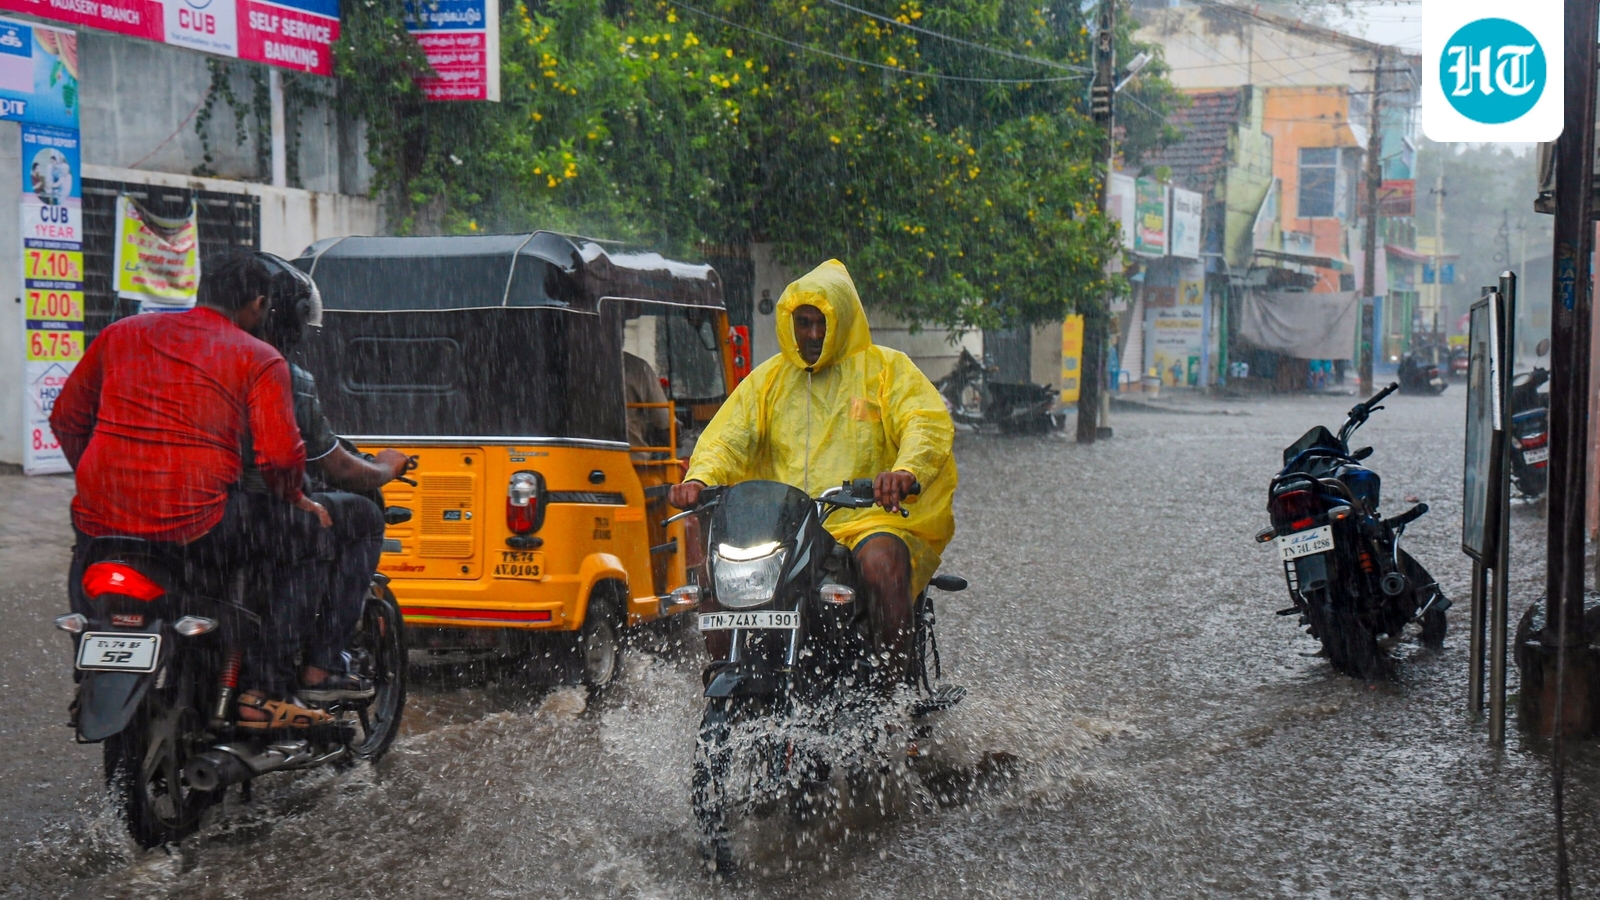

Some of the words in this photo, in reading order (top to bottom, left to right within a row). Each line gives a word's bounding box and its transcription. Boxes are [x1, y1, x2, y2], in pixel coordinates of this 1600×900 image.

[100, 4, 140, 25] BRANCH
[179, 9, 215, 35] CUB
[249, 11, 279, 33] SELF
[281, 18, 330, 44] SERVICE
[264, 41, 318, 67] BANKING
[40, 206, 69, 223] CUB
[30, 251, 79, 278] 7.10%
[33, 280, 54, 288] SENIOR
[29, 292, 80, 318] 7.00%
[31, 332, 81, 357] 6.75%
[1283, 546, 1296, 557] TN
[1297, 543, 1312, 554] 74L
[1313, 538, 1331, 551] 4286
[494, 564, 540, 576] AV.0103
[728, 614, 758, 627] 74AX
[768, 614, 799, 626] 1901
[111, 641, 126, 649] 74
[100, 651, 133, 663] 52
